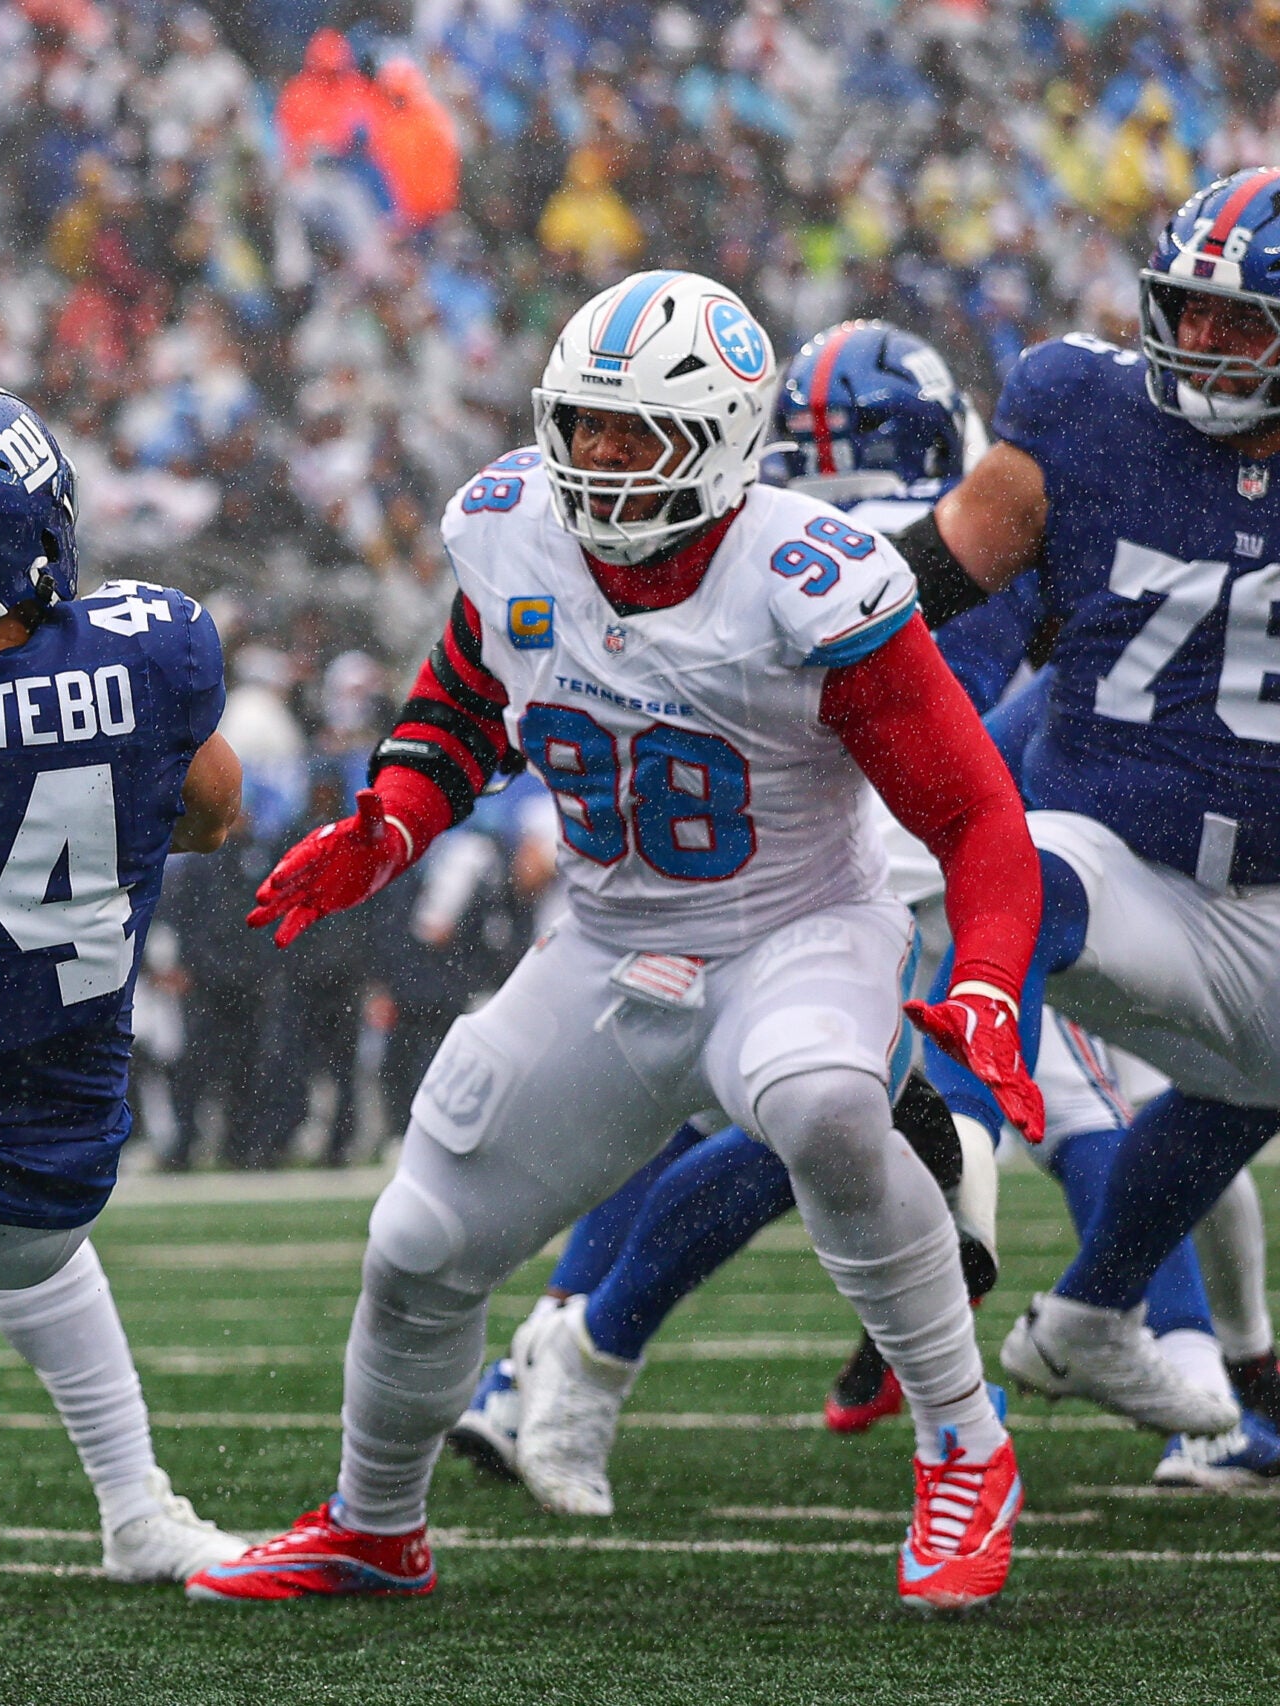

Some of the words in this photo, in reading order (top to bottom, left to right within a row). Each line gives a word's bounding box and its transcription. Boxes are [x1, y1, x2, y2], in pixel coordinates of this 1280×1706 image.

[1183, 217, 1254, 262] 76
[581, 373, 623, 387] TITANS
[770, 516, 876, 597] 98
[81, 579, 173, 637] 44
[511, 601, 550, 635] C
[1093, 537, 1280, 744] 76
[555, 676, 696, 717] TENNESSEE
[517, 701, 757, 882] 98
